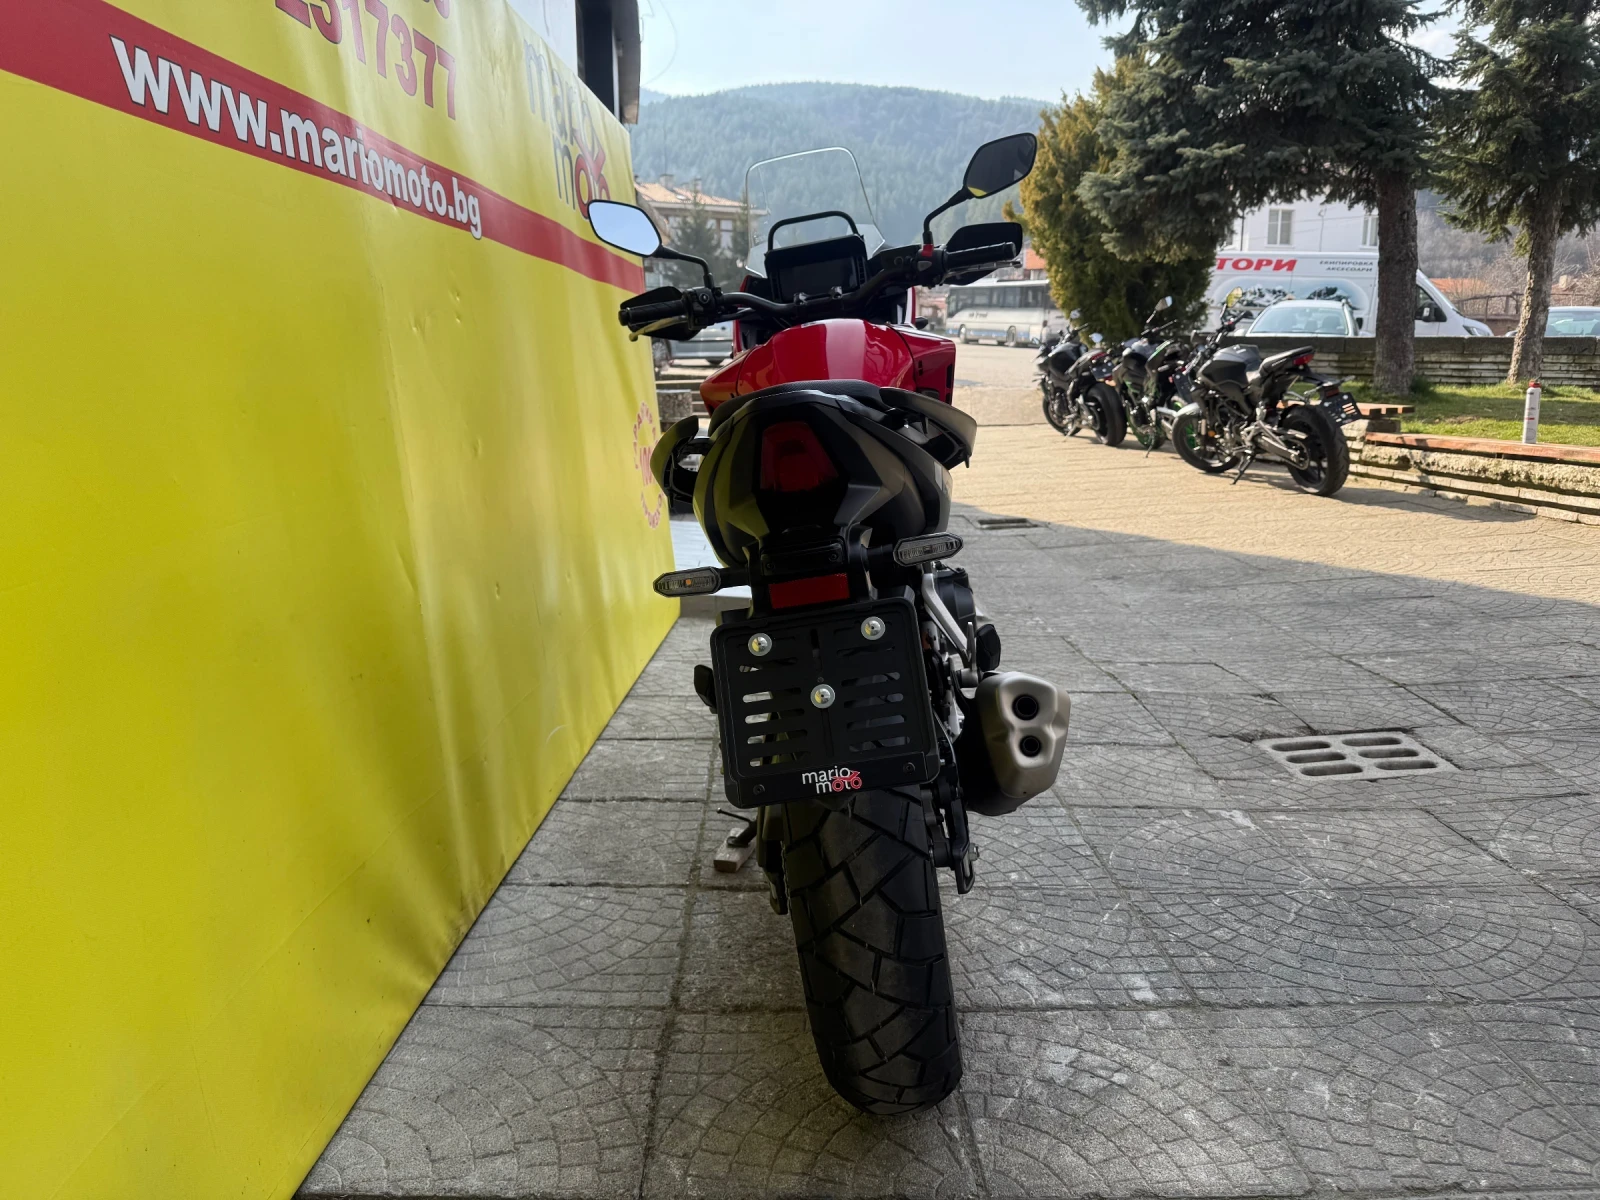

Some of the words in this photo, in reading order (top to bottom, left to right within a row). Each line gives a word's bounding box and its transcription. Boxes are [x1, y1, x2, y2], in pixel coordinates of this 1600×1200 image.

[109, 34, 482, 240] www.mariomoto.bg
[801, 765, 851, 785] mario
[815, 776, 863, 794] moto
